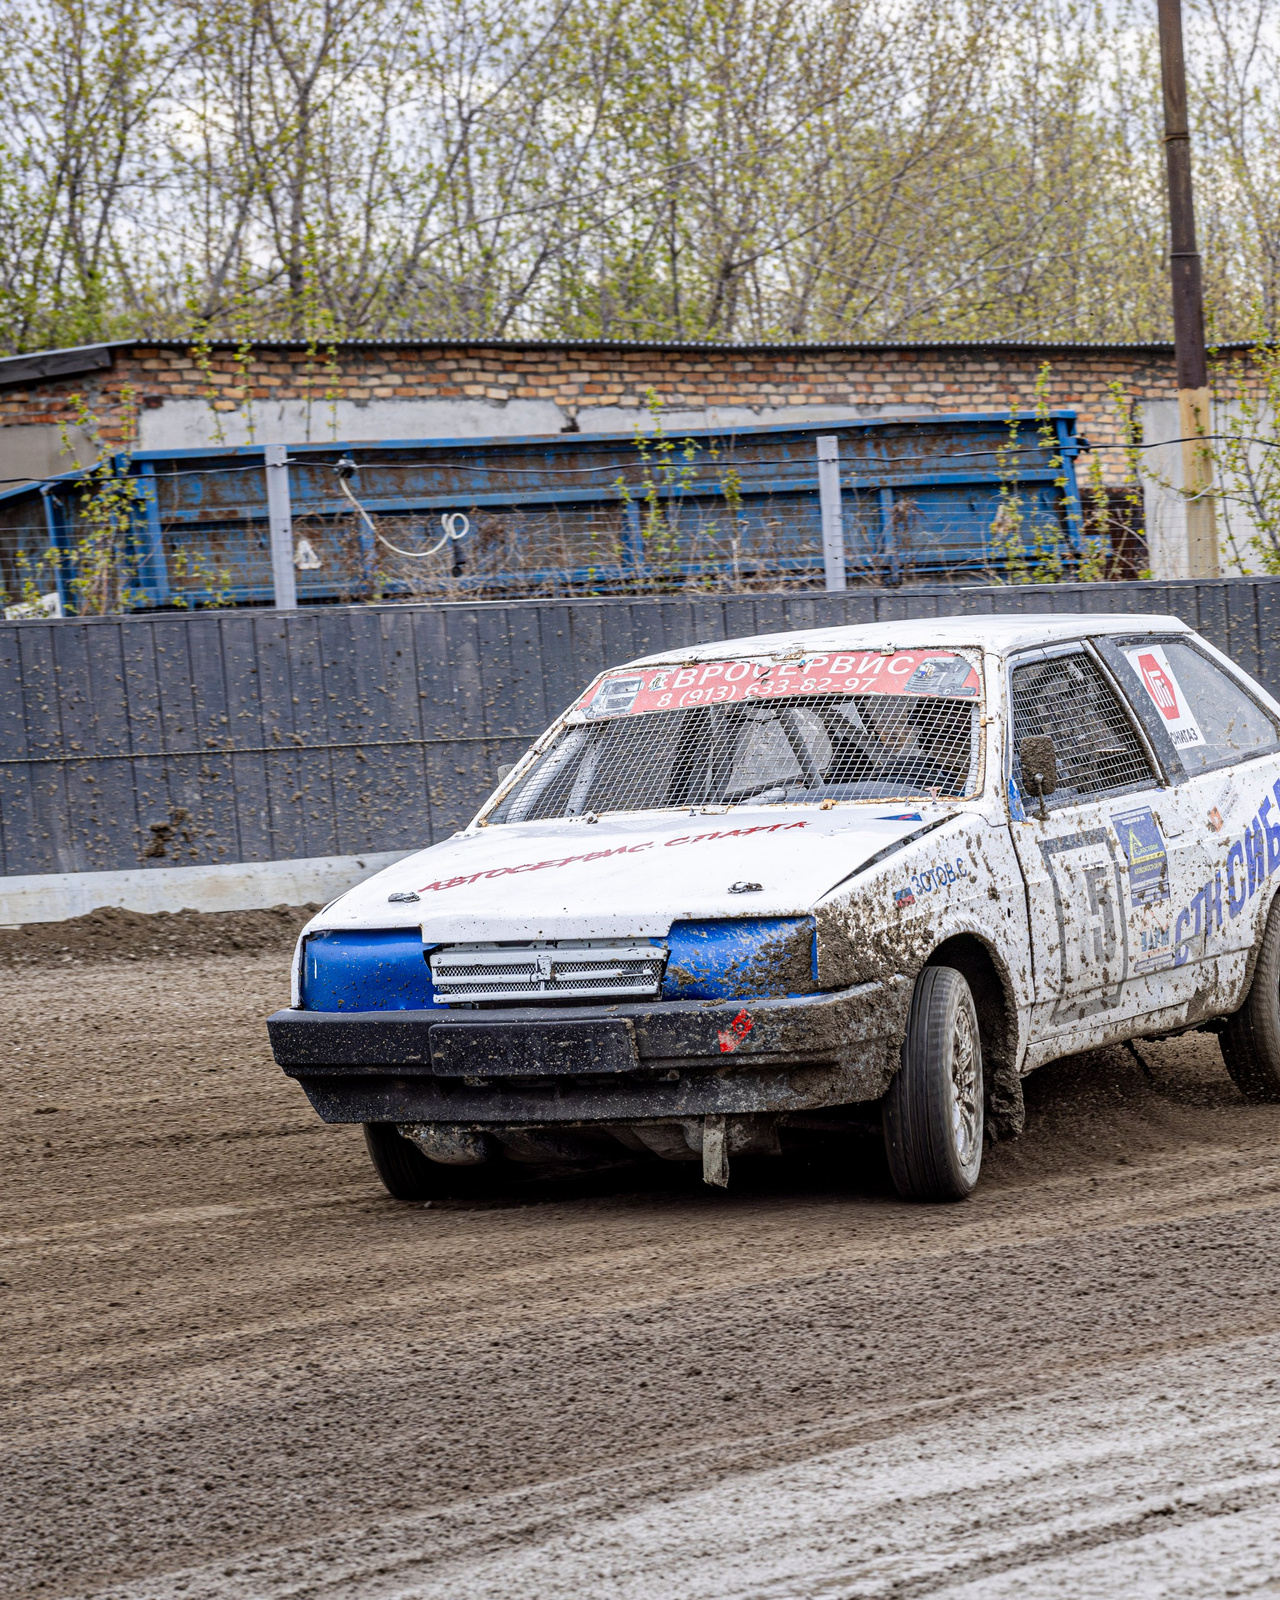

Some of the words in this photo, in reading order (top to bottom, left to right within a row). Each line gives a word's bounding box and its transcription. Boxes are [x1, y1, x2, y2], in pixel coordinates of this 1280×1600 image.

[656, 693, 672, 708] 8
[680, 685, 737, 708] (913)
[744, 678, 877, 697] 633-82-97
[418, 841, 654, 893] АВТОСЕРВИС
[664, 821, 813, 847] СПАРТА
